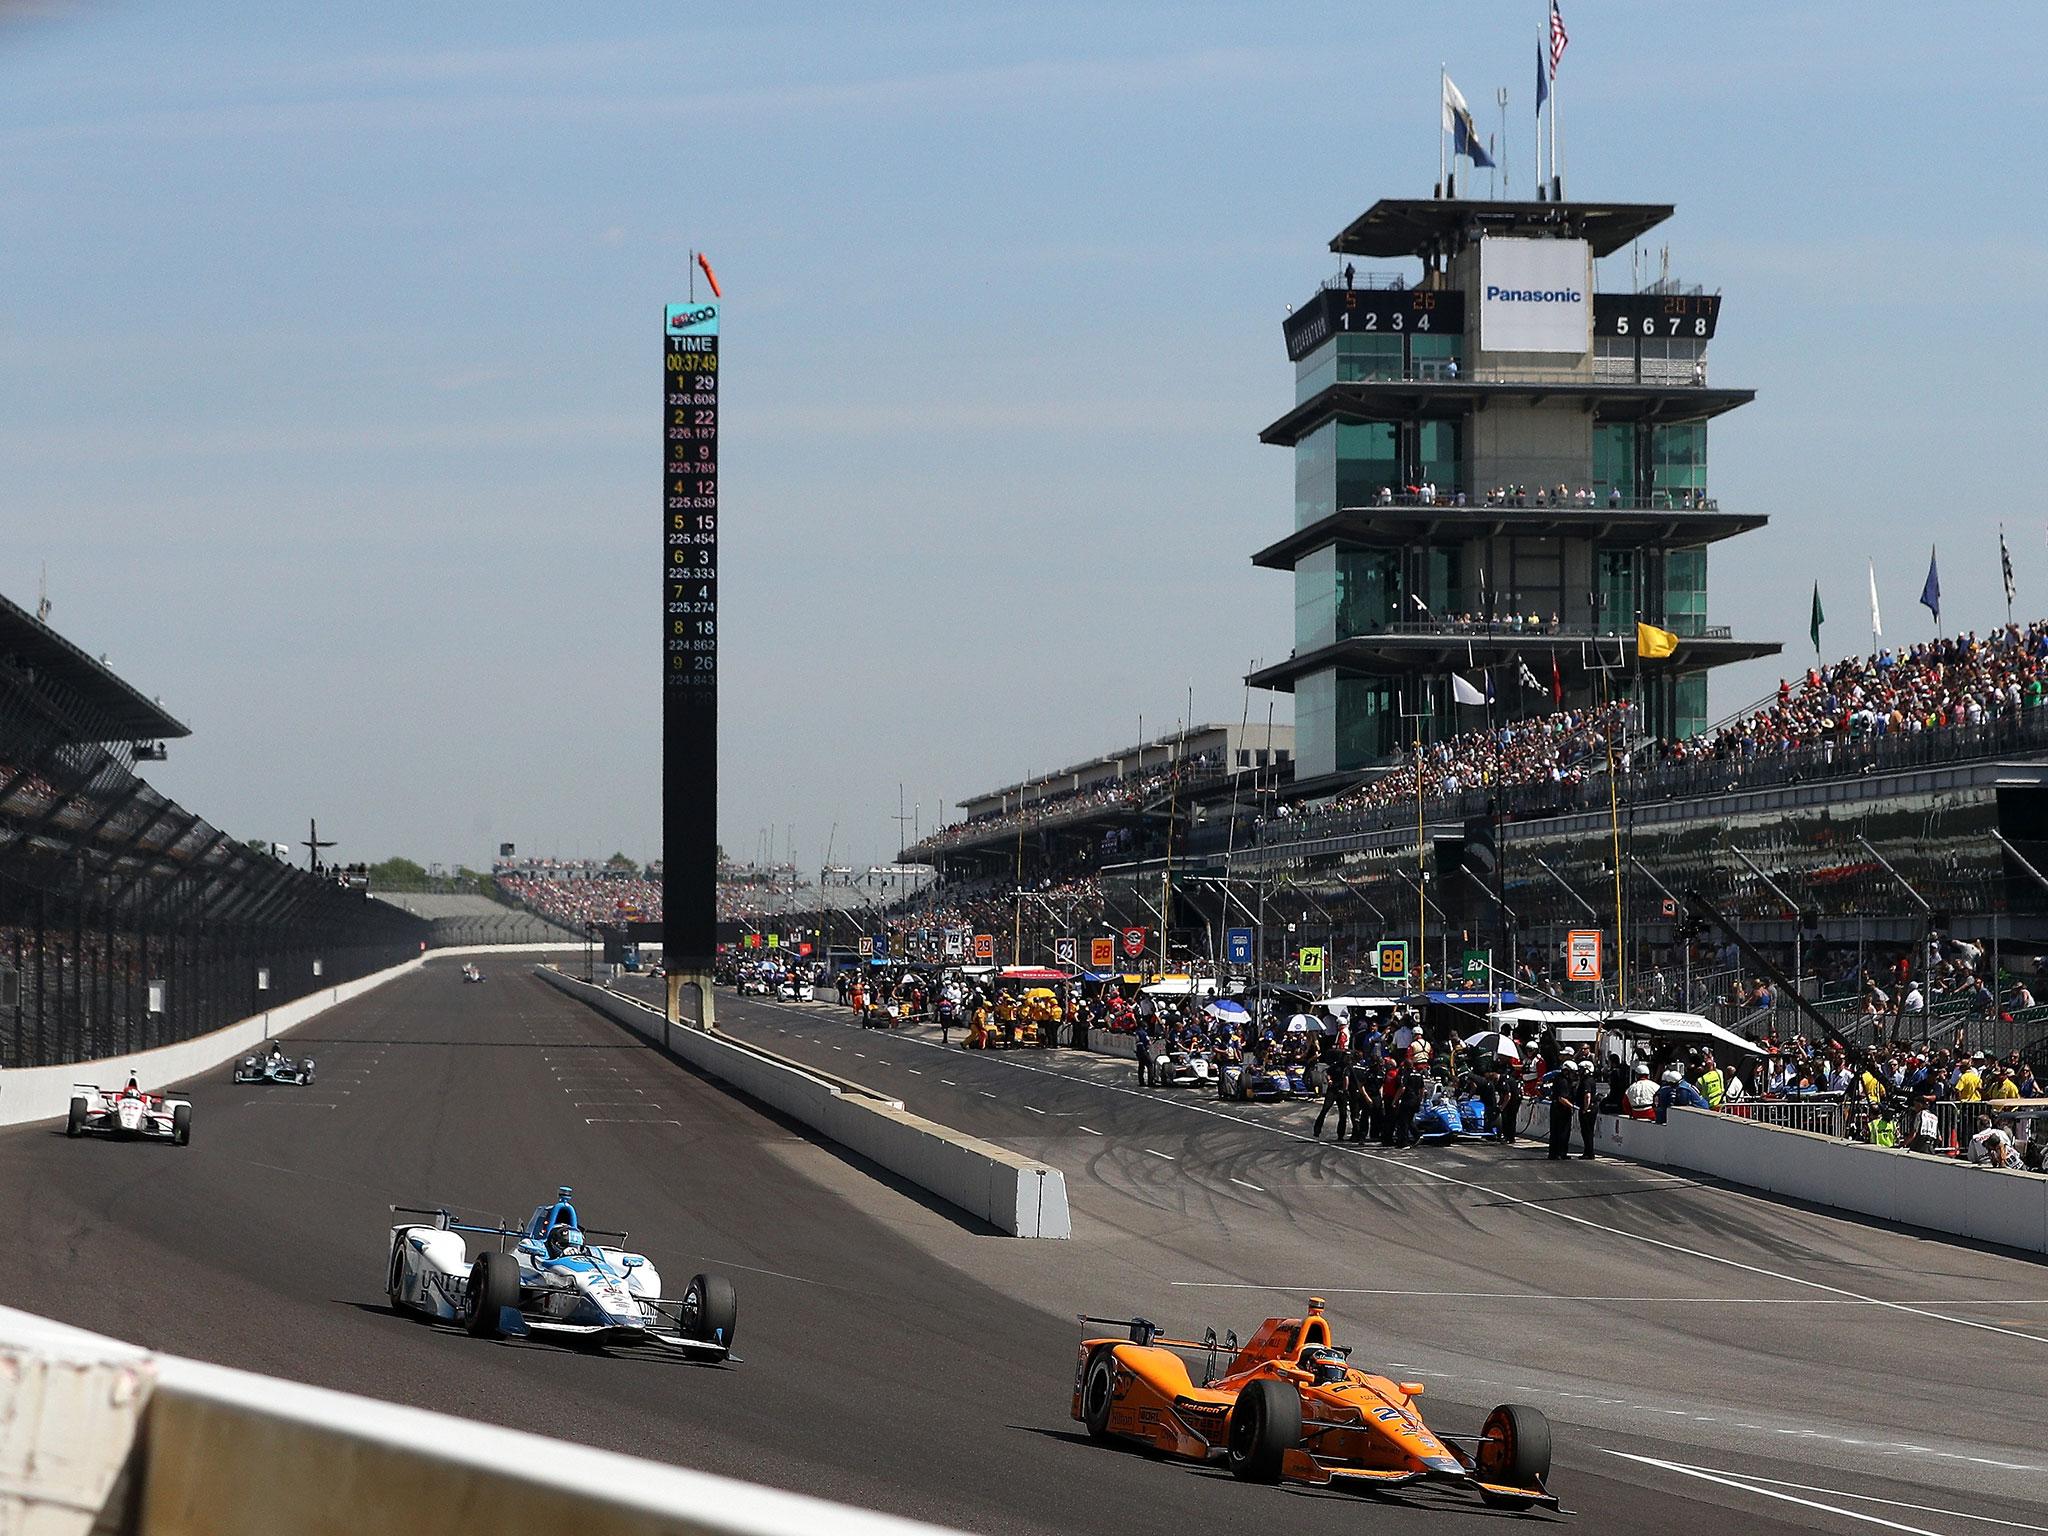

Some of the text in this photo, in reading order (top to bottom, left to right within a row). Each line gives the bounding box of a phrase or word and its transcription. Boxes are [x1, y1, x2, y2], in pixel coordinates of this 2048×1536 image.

[1413, 292, 1435, 310] 26
[1487, 286, 1581, 303] Panasonic
[1340, 313, 1430, 331] 1 2 3 4
[1617, 317, 1706, 335] 5 6 7 8
[671, 337, 713, 352] TIME
[667, 353, 717, 372] 00:37:49
[677, 374, 715, 390] 1 29
[675, 410, 715, 425] 2 22
[675, 445, 710, 460] 3 9
[674, 480, 715, 495] 4 12
[674, 515, 715, 530] 5 15
[669, 533, 715, 545] 225.454
[674, 550, 709, 565] 6 3
[669, 567, 715, 579] 225.333
[674, 585, 708, 599] 7 4
[669, 602, 715, 613] 225.274
[674, 620, 715, 635] 8 18
[673, 656, 714, 670] 9 26
[977, 940, 991, 952] 29
[1059, 943, 1073, 959] 26
[1095, 945, 1110, 959] 28
[1235, 947, 1244, 957] 10
[1303, 952, 1319, 966] 21
[1382, 949, 1403, 972] 98
[1580, 958, 1588, 971] 9
